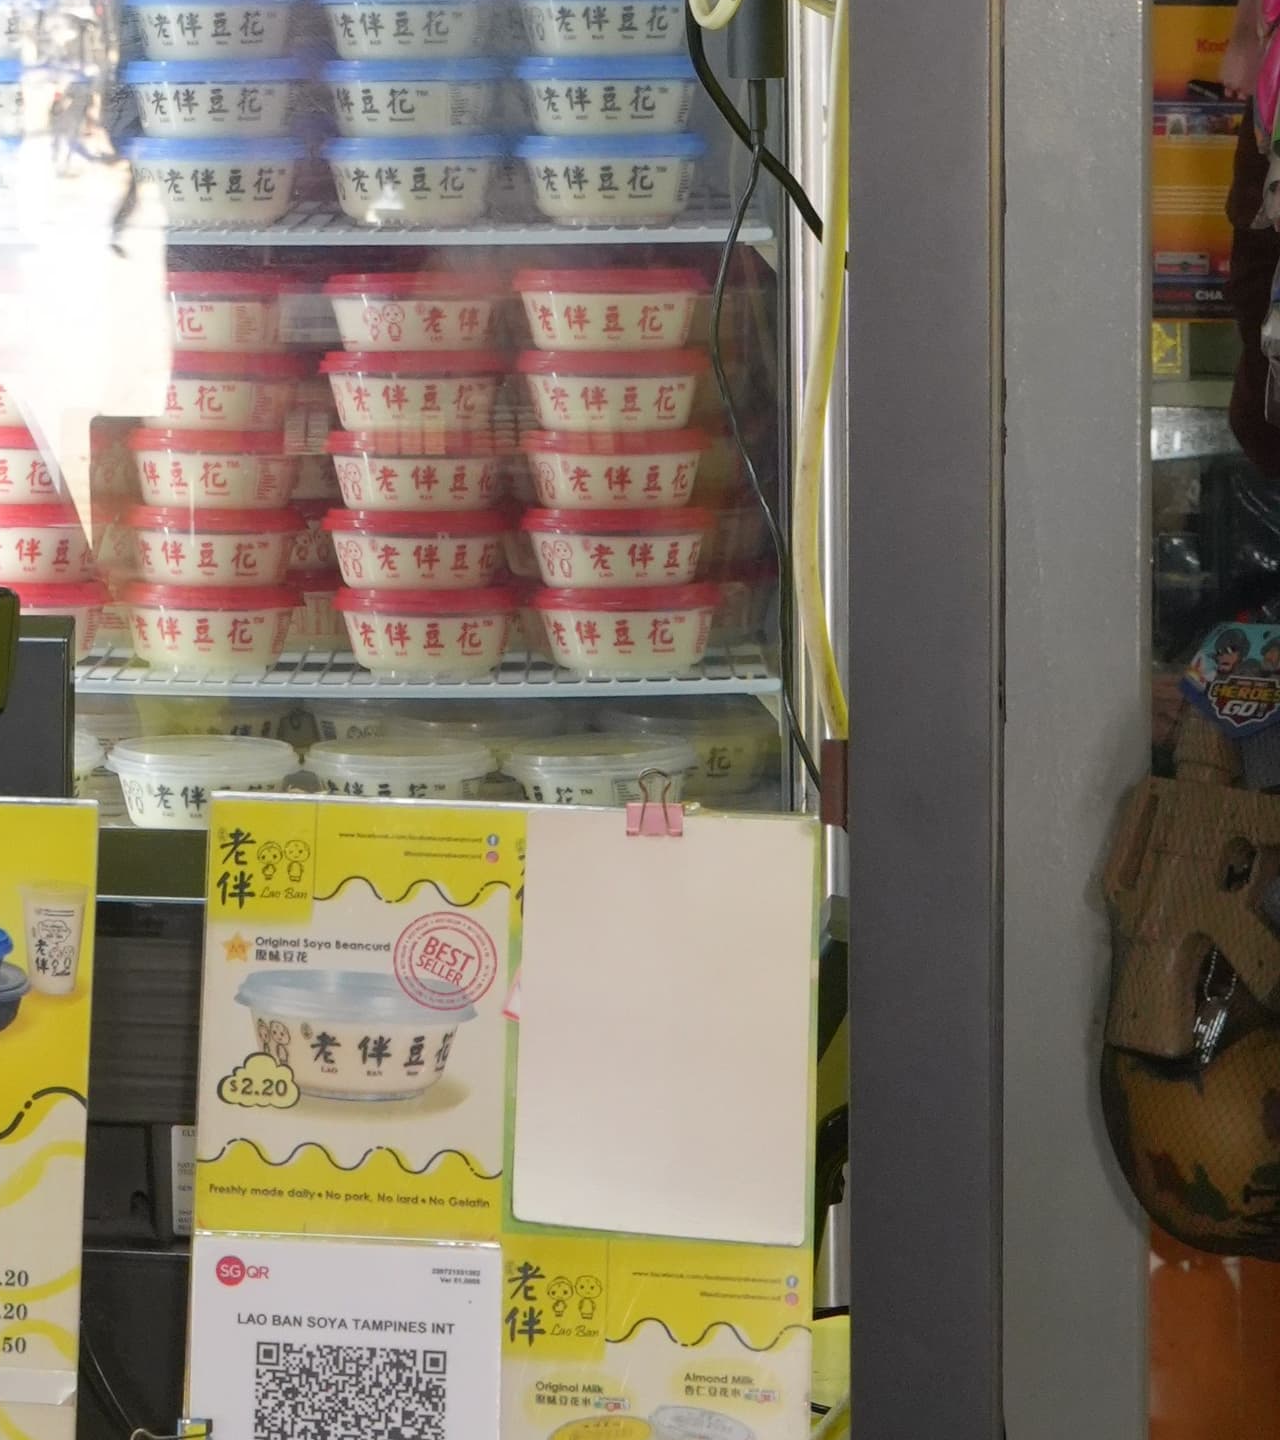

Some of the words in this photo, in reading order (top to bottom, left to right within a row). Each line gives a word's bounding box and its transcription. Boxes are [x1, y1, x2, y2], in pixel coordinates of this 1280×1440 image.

[555, 5, 668, 33] 老伴豆花
[549, 385, 677, 413] 老伴豆花
[569, 465, 689, 492] 老伴豆花
[359, 620, 483, 648] 老伴豆花
[423, 936, 475, 973] BEST
[416, 955, 463, 986] SELLER
[229, 1077, 288, 1097] $2.20
[237, 1313, 268, 1326] LAO
[272, 1314, 303, 1328] BAN
[307, 1317, 348, 1330] SOYA
[352, 1318, 427, 1334] TAMPINES
[431, 1322, 455, 1335] INT
